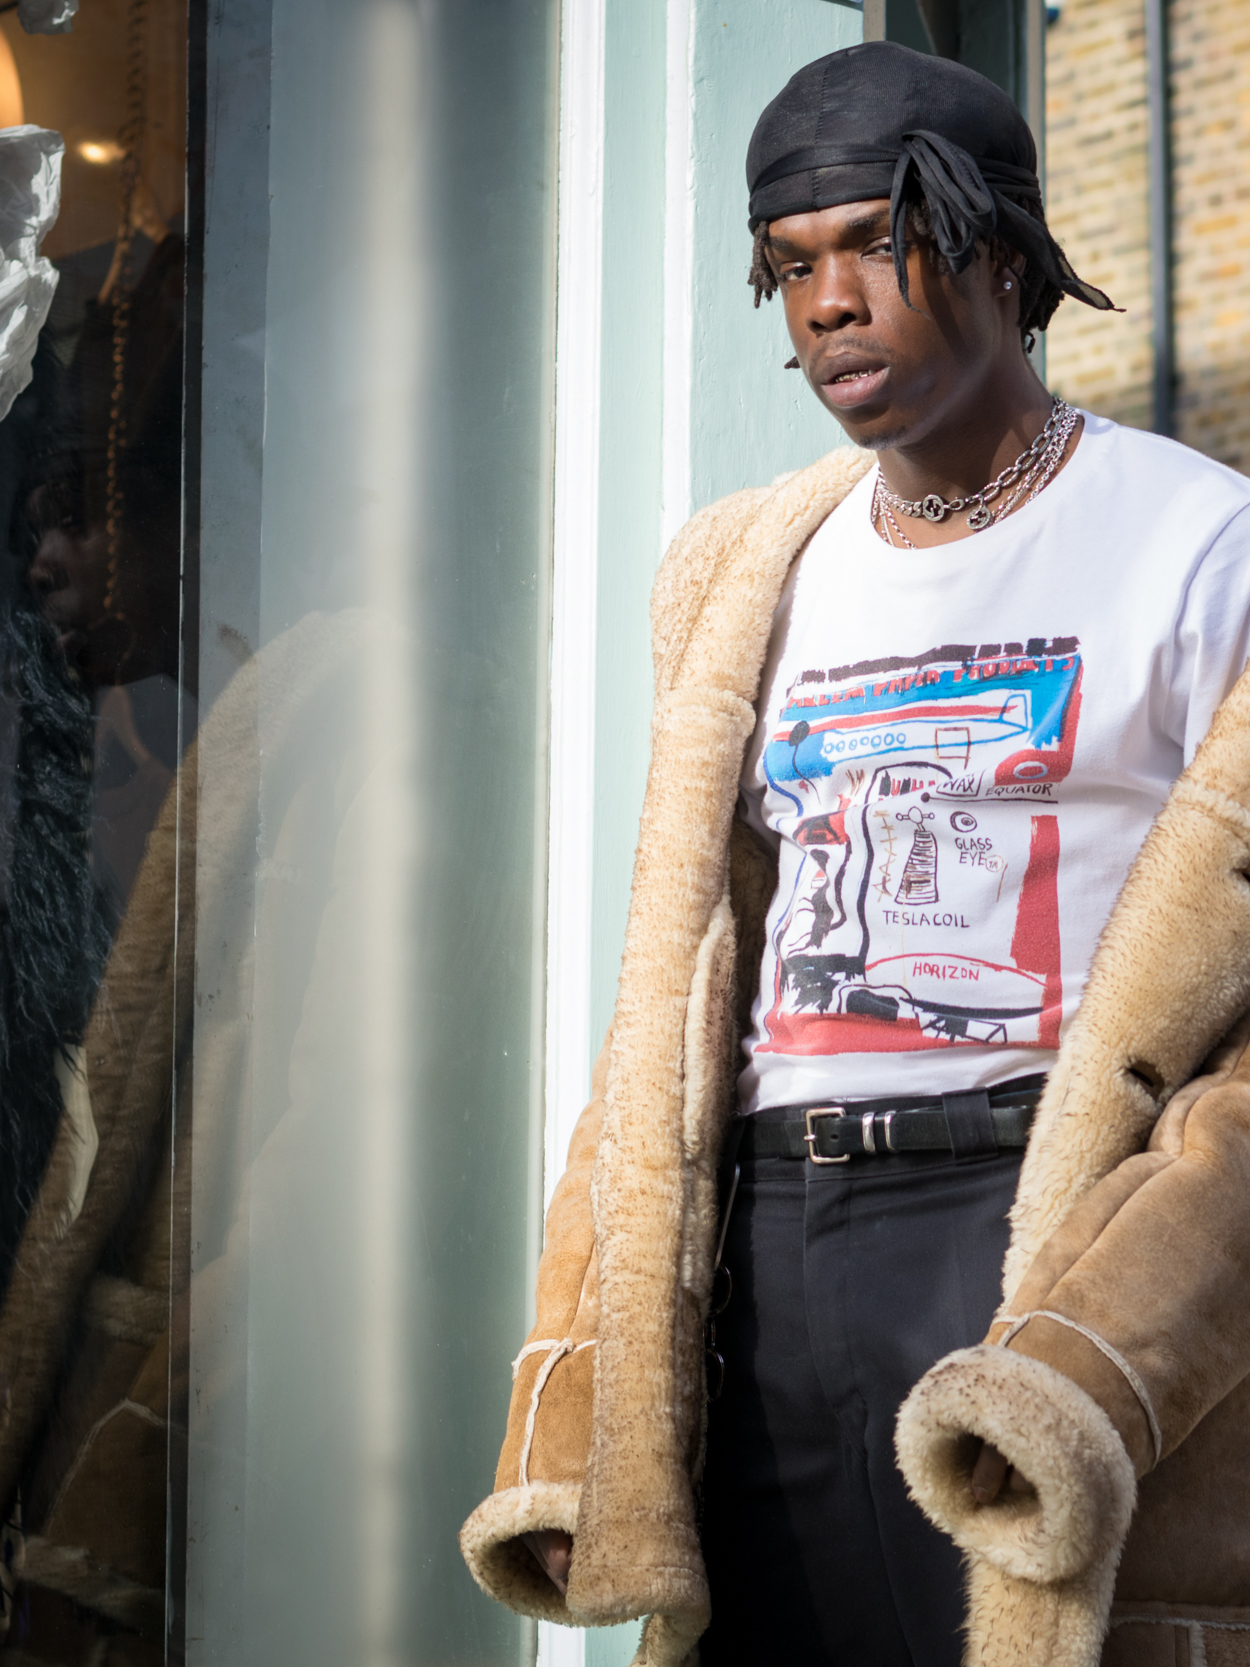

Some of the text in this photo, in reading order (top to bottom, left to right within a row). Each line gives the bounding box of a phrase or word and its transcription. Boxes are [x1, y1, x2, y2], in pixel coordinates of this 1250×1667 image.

[985, 782, 1053, 797] EQUATOR
[954, 837, 993, 851] GLASS
[958, 851, 986, 867] EYE
[912, 961, 980, 981] HORIZON
